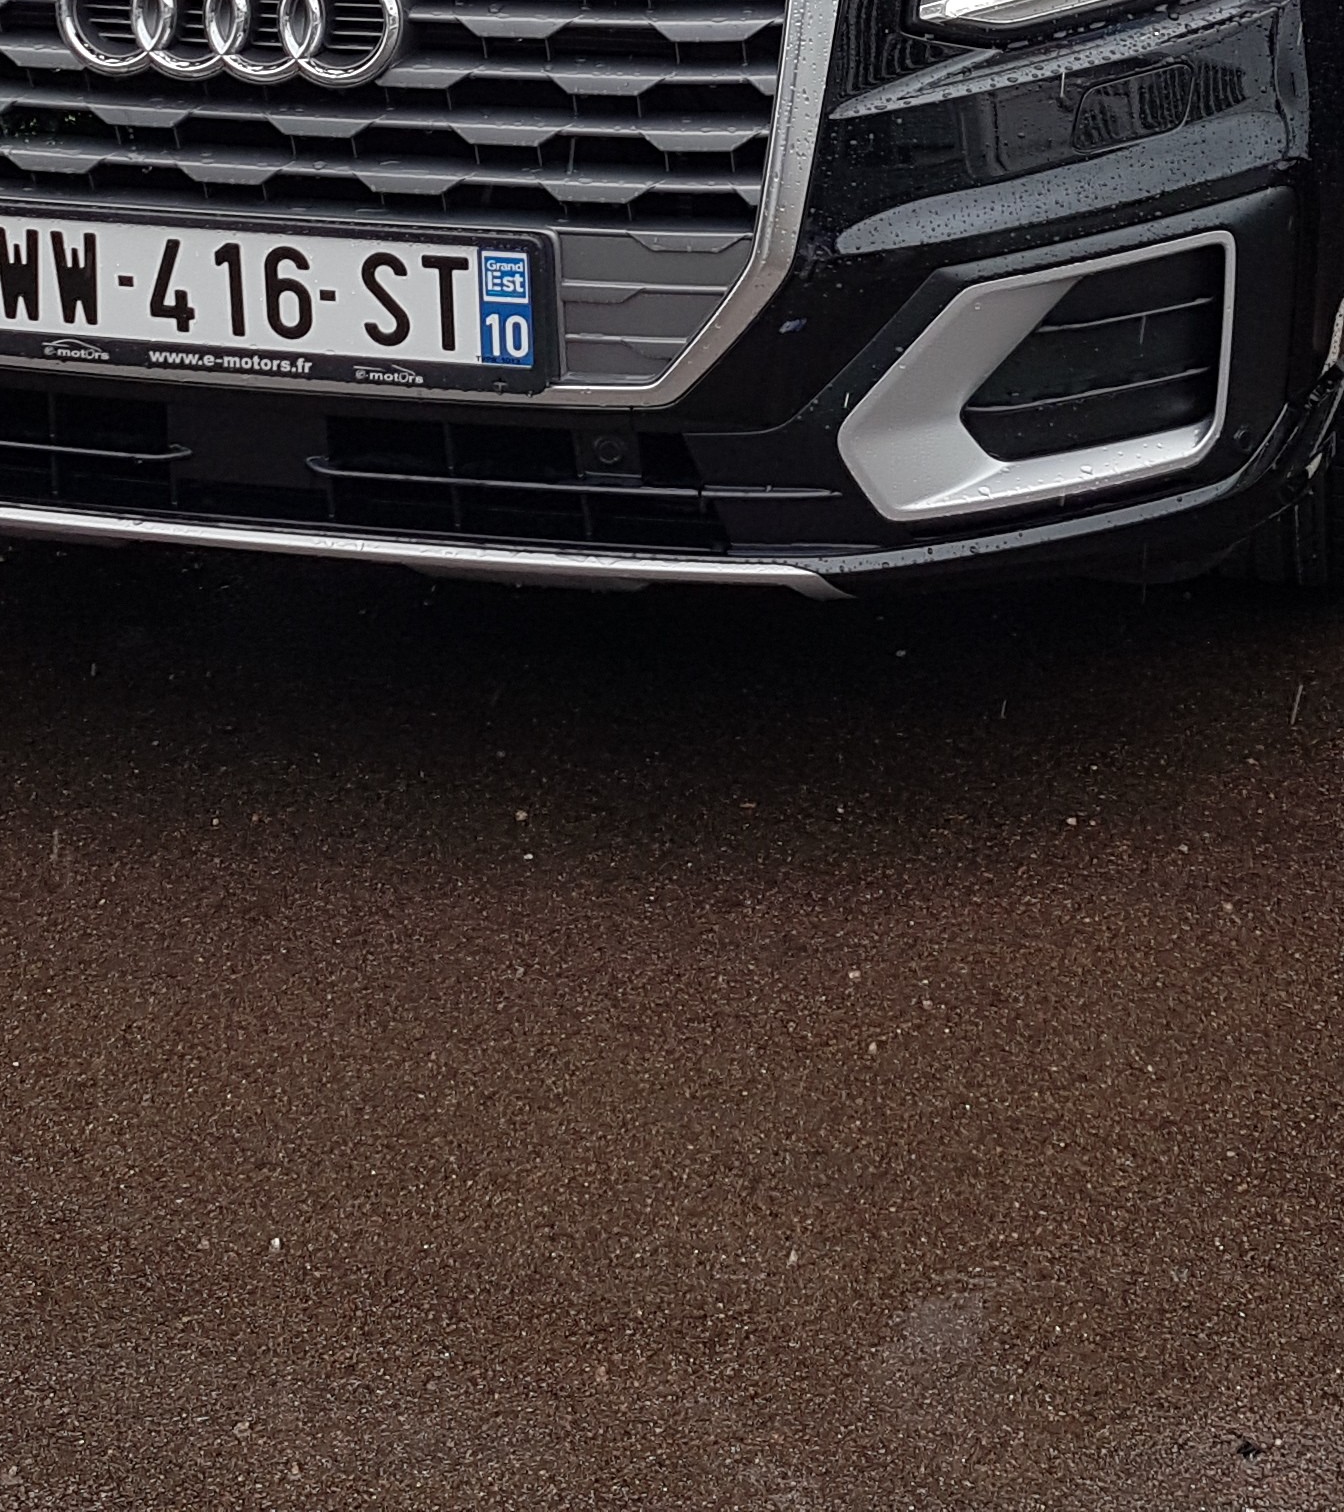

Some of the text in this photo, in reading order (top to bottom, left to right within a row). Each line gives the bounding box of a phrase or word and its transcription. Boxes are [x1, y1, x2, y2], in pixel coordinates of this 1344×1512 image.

[486, 259, 524, 273] Grand
[487, 271, 524, 293] Est
[485, 313, 529, 358] 10
[148, 350, 313, 374] www.e-motors.fr
